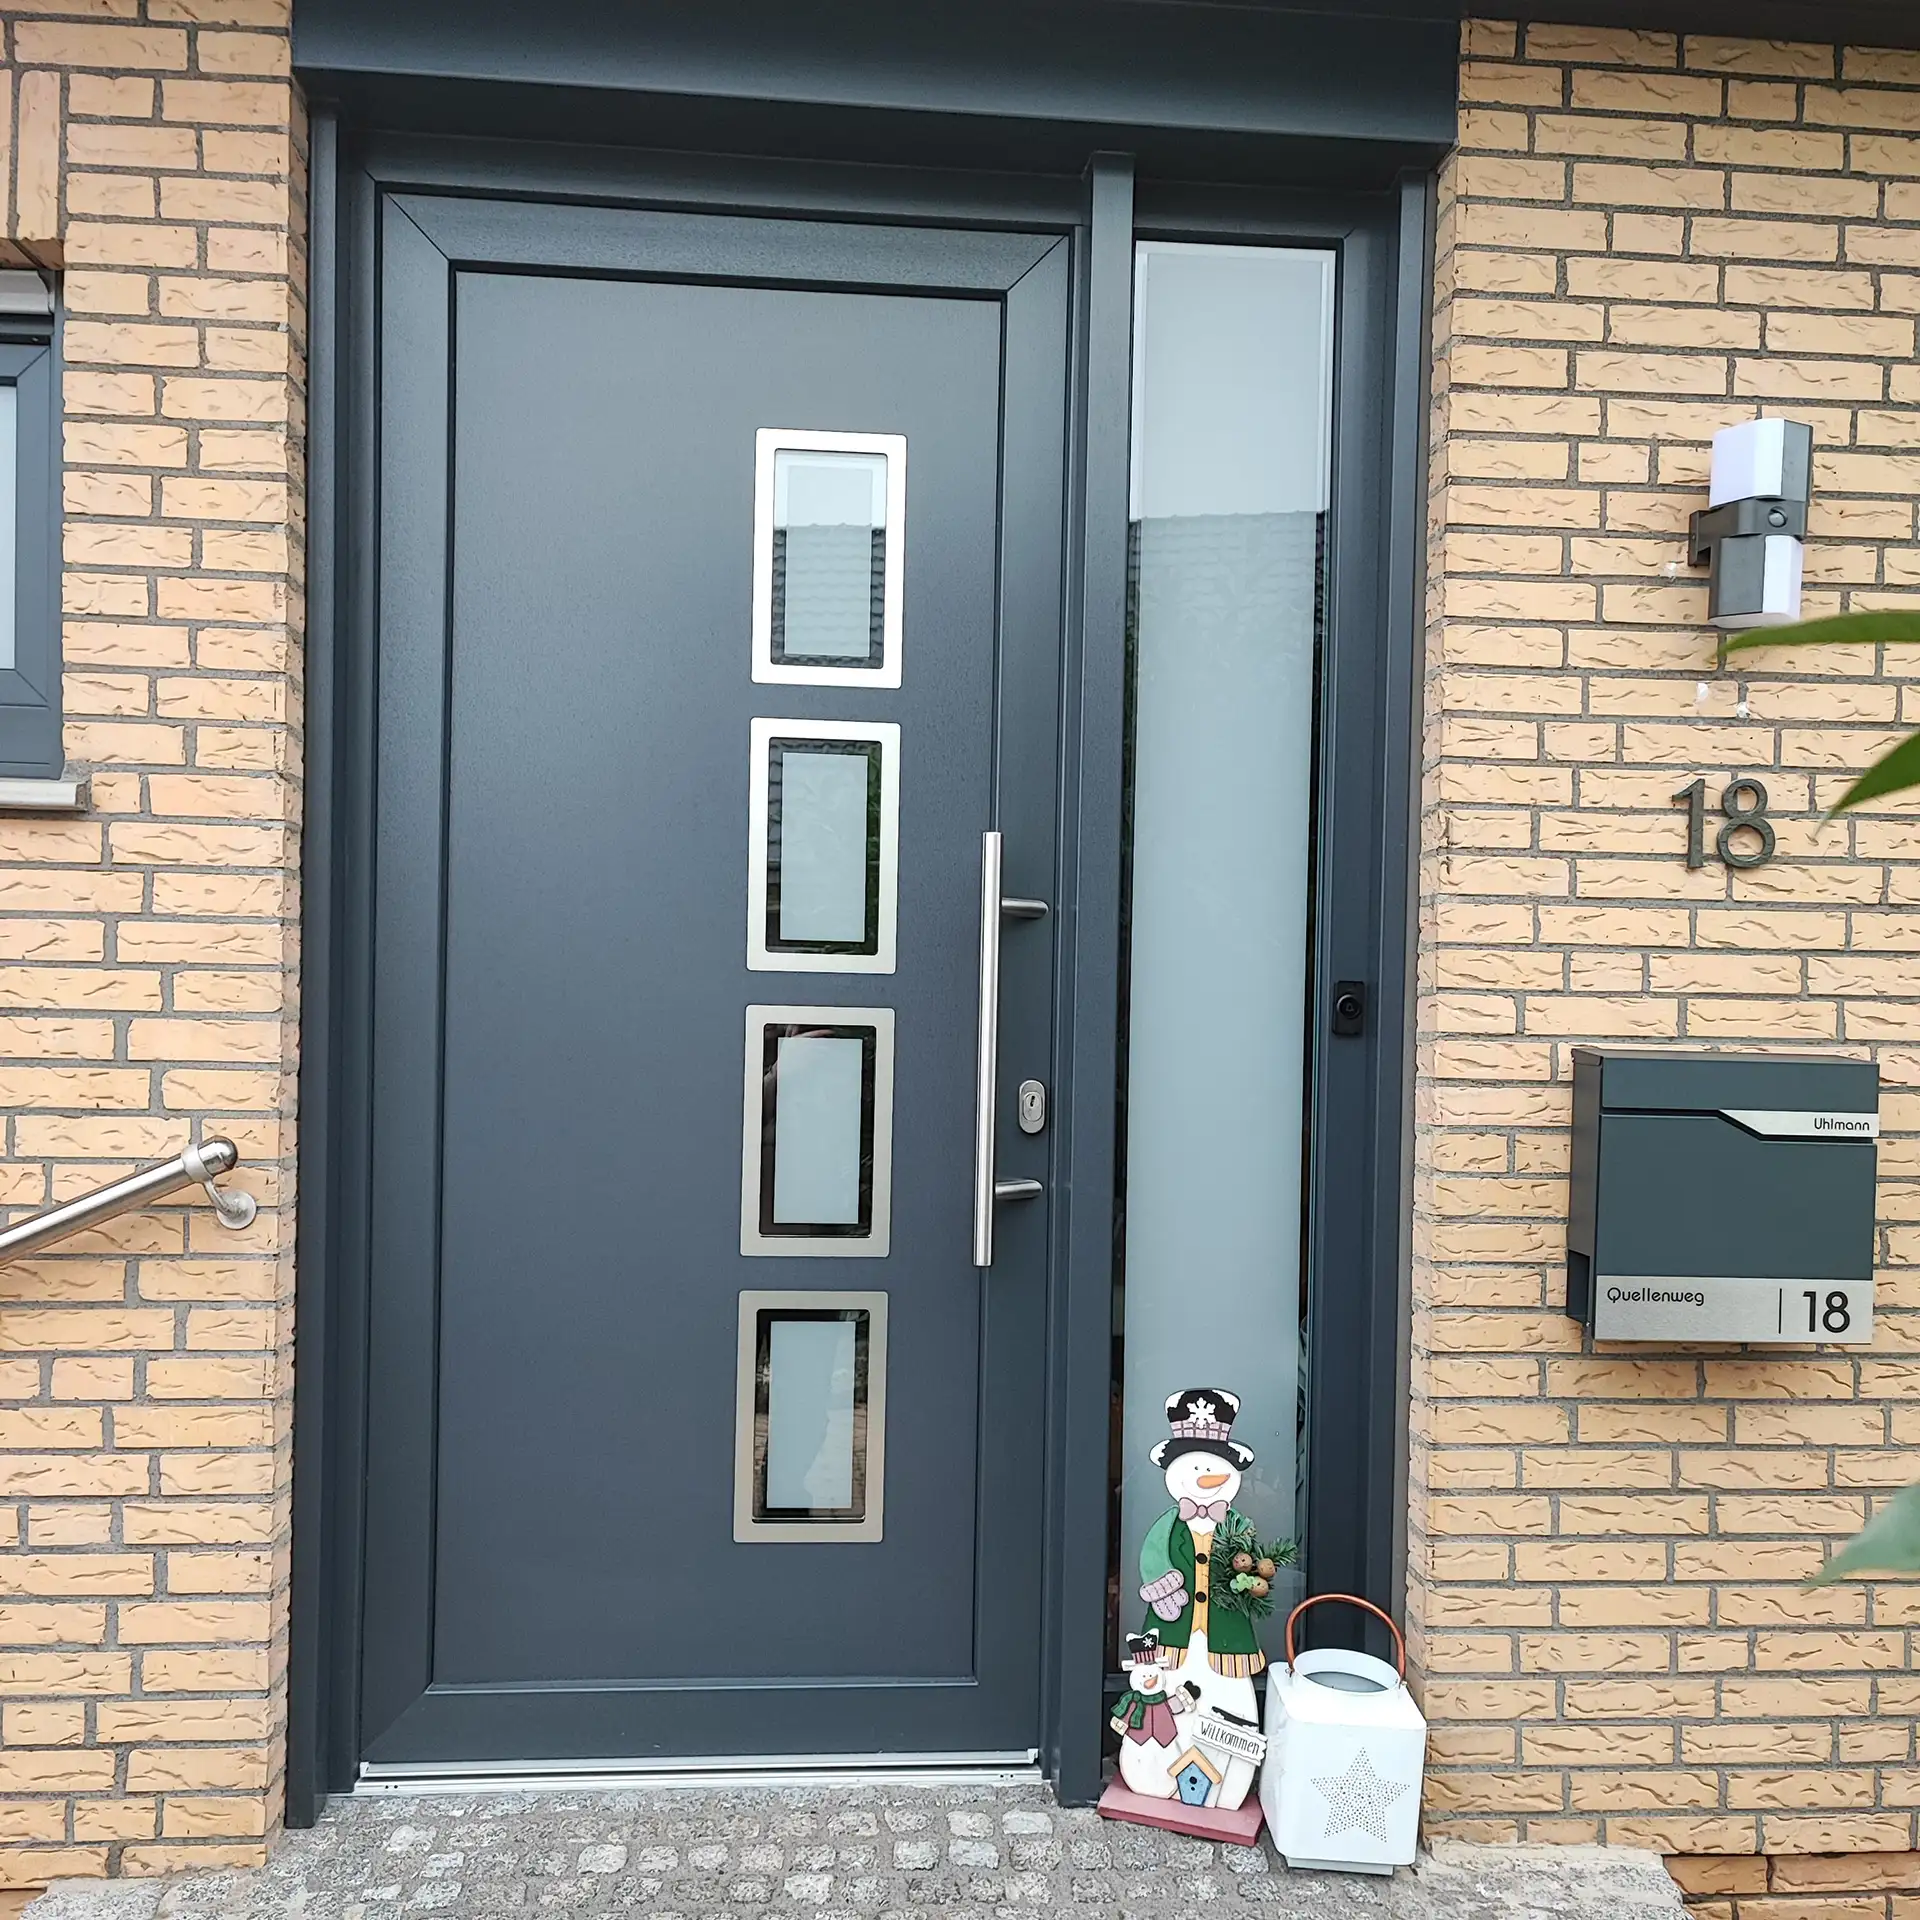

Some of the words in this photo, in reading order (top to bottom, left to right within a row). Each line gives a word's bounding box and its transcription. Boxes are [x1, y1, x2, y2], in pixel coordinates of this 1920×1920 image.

[1671, 778, 1775, 868] 18
[1814, 1117, 1870, 1131] Uhlmann
[1607, 1287, 1704, 1306] Quellenweg
[1803, 1291, 1850, 1333] 18
